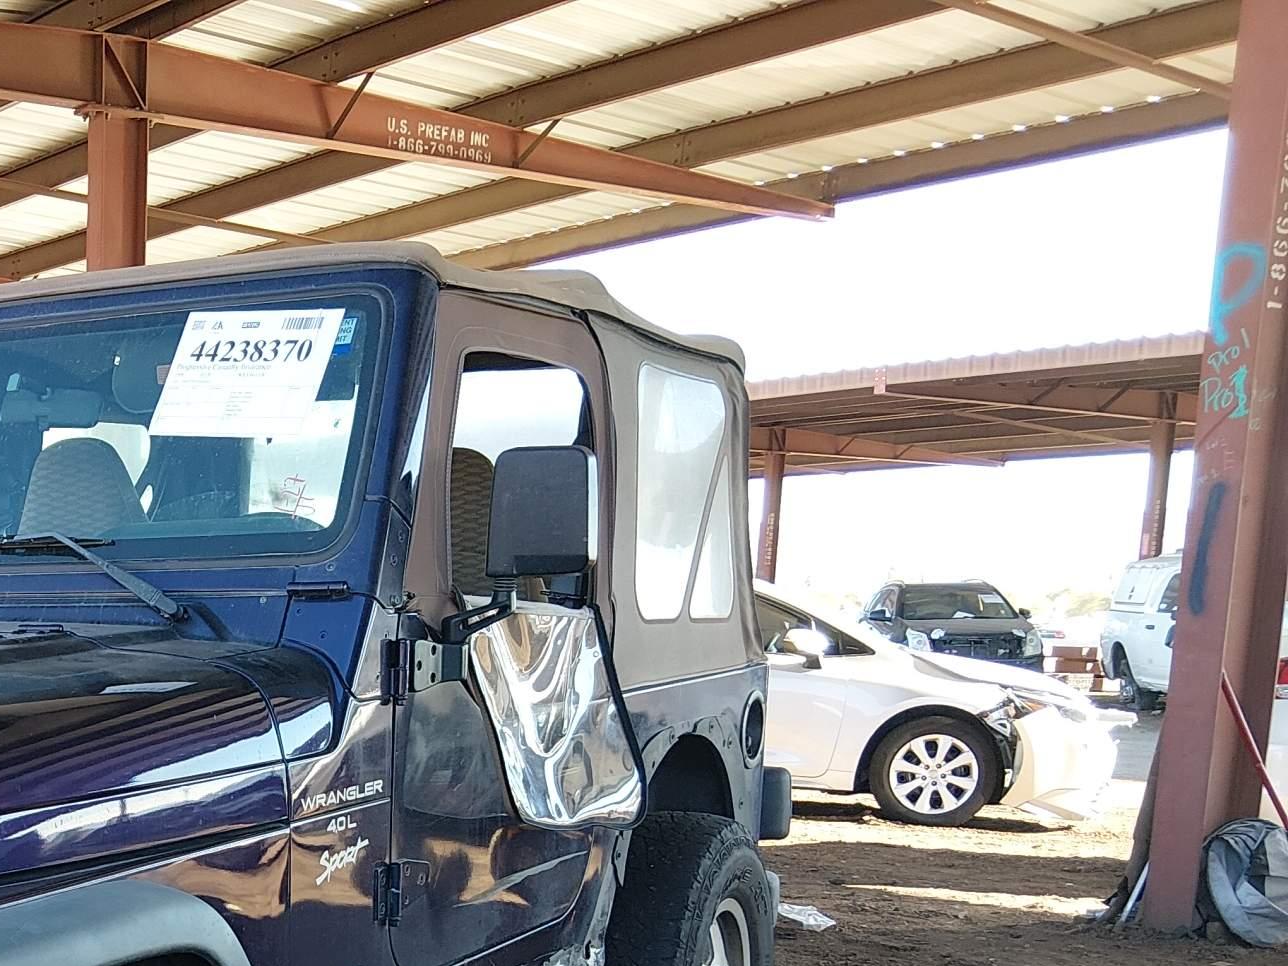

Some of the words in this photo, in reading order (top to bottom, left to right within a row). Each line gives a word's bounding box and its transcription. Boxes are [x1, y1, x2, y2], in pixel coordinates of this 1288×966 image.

[387, 117, 411, 135] U.S.
[418, 122, 465, 143] PREFAB
[470, 131, 490, 147] INC
[189, 338, 313, 363] 44238370
[301, 779, 384, 811] WRANGLER
[315, 836, 370, 886] Sport
